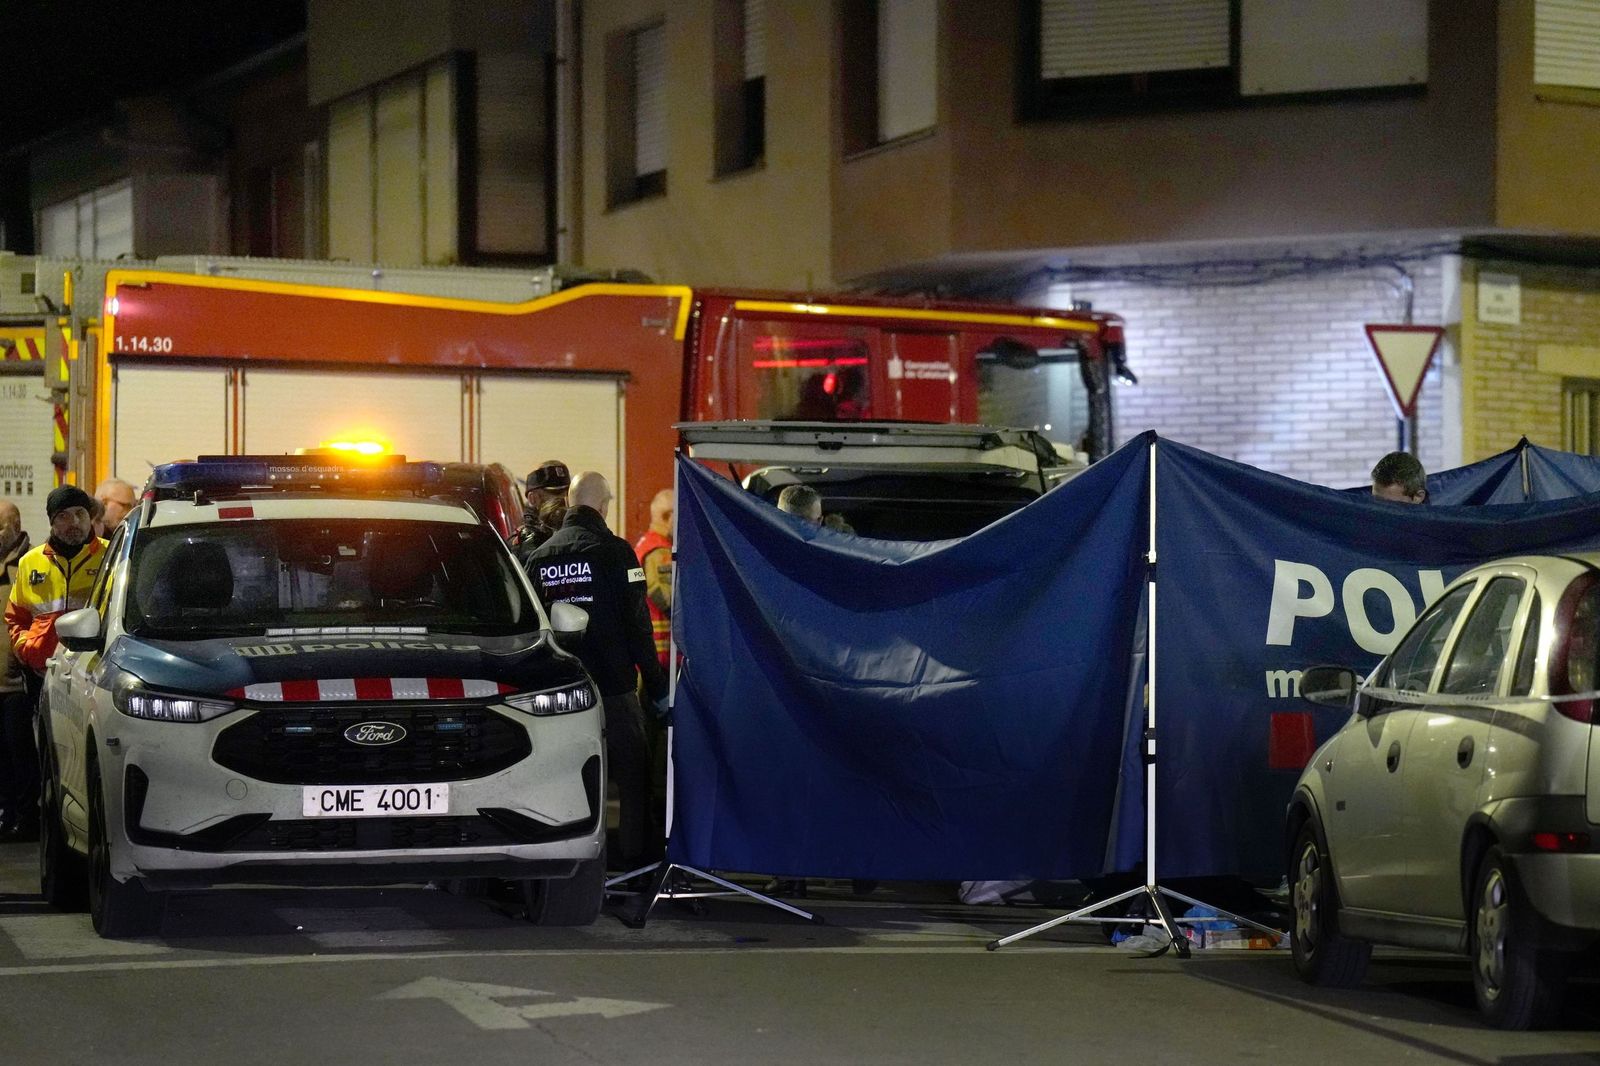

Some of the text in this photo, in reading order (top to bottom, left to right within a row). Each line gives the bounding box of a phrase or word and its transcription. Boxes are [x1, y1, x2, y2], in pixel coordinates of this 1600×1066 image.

[115, 336, 172, 352] 1.14.30
[269, 465, 300, 473] mossos
[540, 562, 592, 580] POLICIA
[301, 641, 482, 654] policia
[354, 724, 396, 743] Ford
[321, 789, 433, 811] CME 4001
